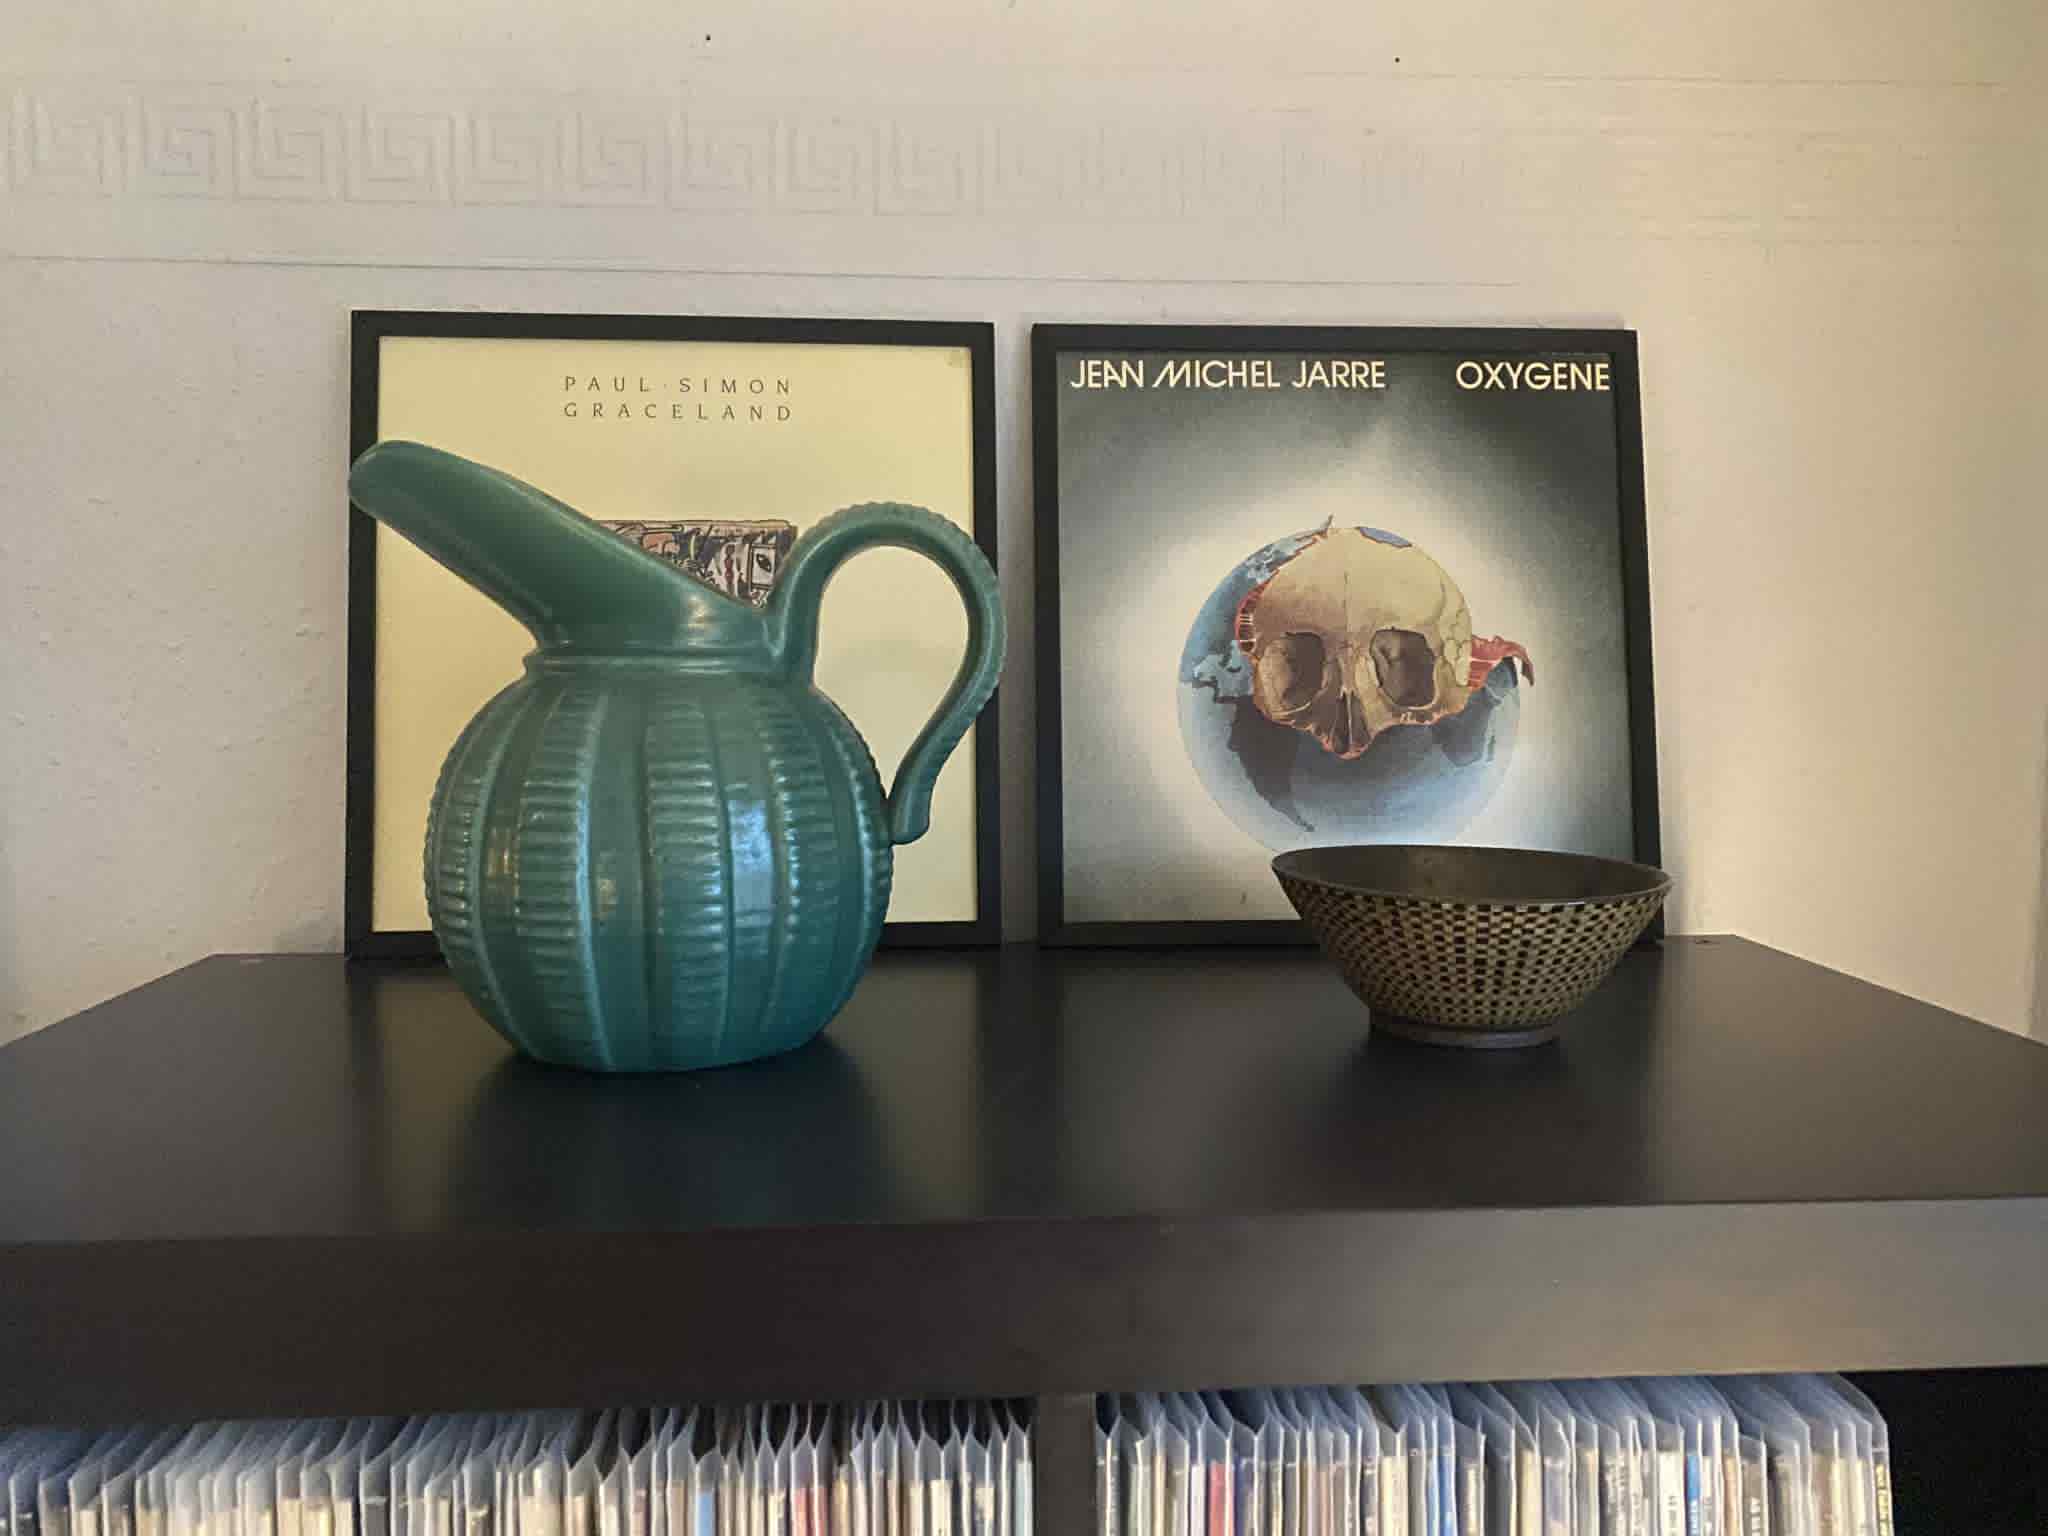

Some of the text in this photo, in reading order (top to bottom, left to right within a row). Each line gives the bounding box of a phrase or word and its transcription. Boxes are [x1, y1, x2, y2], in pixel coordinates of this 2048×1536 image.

[564, 375, 790, 394] PAUL SIMON
[1070, 360, 1385, 389] JEAN MICHEL JARRE
[1455, 361, 1610, 390] OXYGENE
[563, 402, 791, 421] GRACELAND
